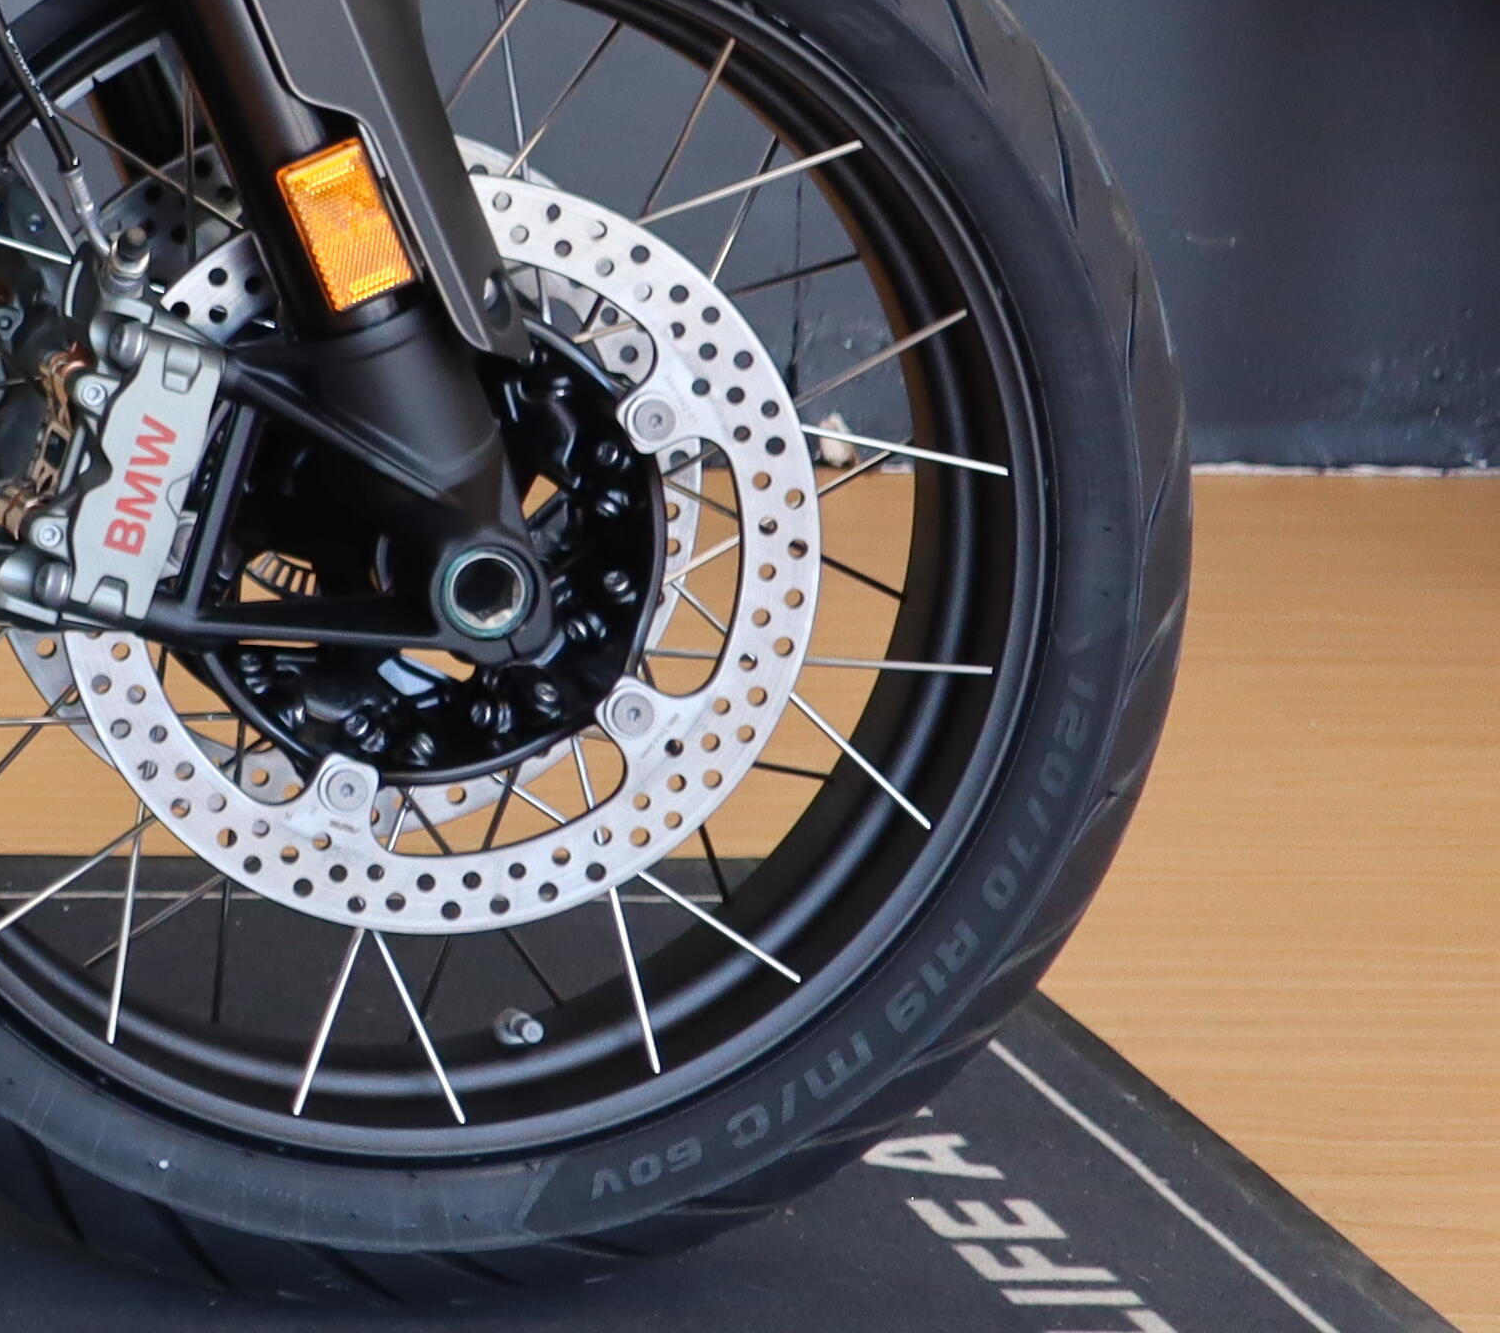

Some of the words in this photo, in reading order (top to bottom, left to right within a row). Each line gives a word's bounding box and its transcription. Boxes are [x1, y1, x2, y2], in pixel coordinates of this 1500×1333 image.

[104, 413, 179, 557] BMW
[970, 671, 1104, 917] 120/70
[876, 915, 987, 1035] R19
[716, 1026, 879, 1156] M/C
[579, 1130, 708, 1205] 60V
